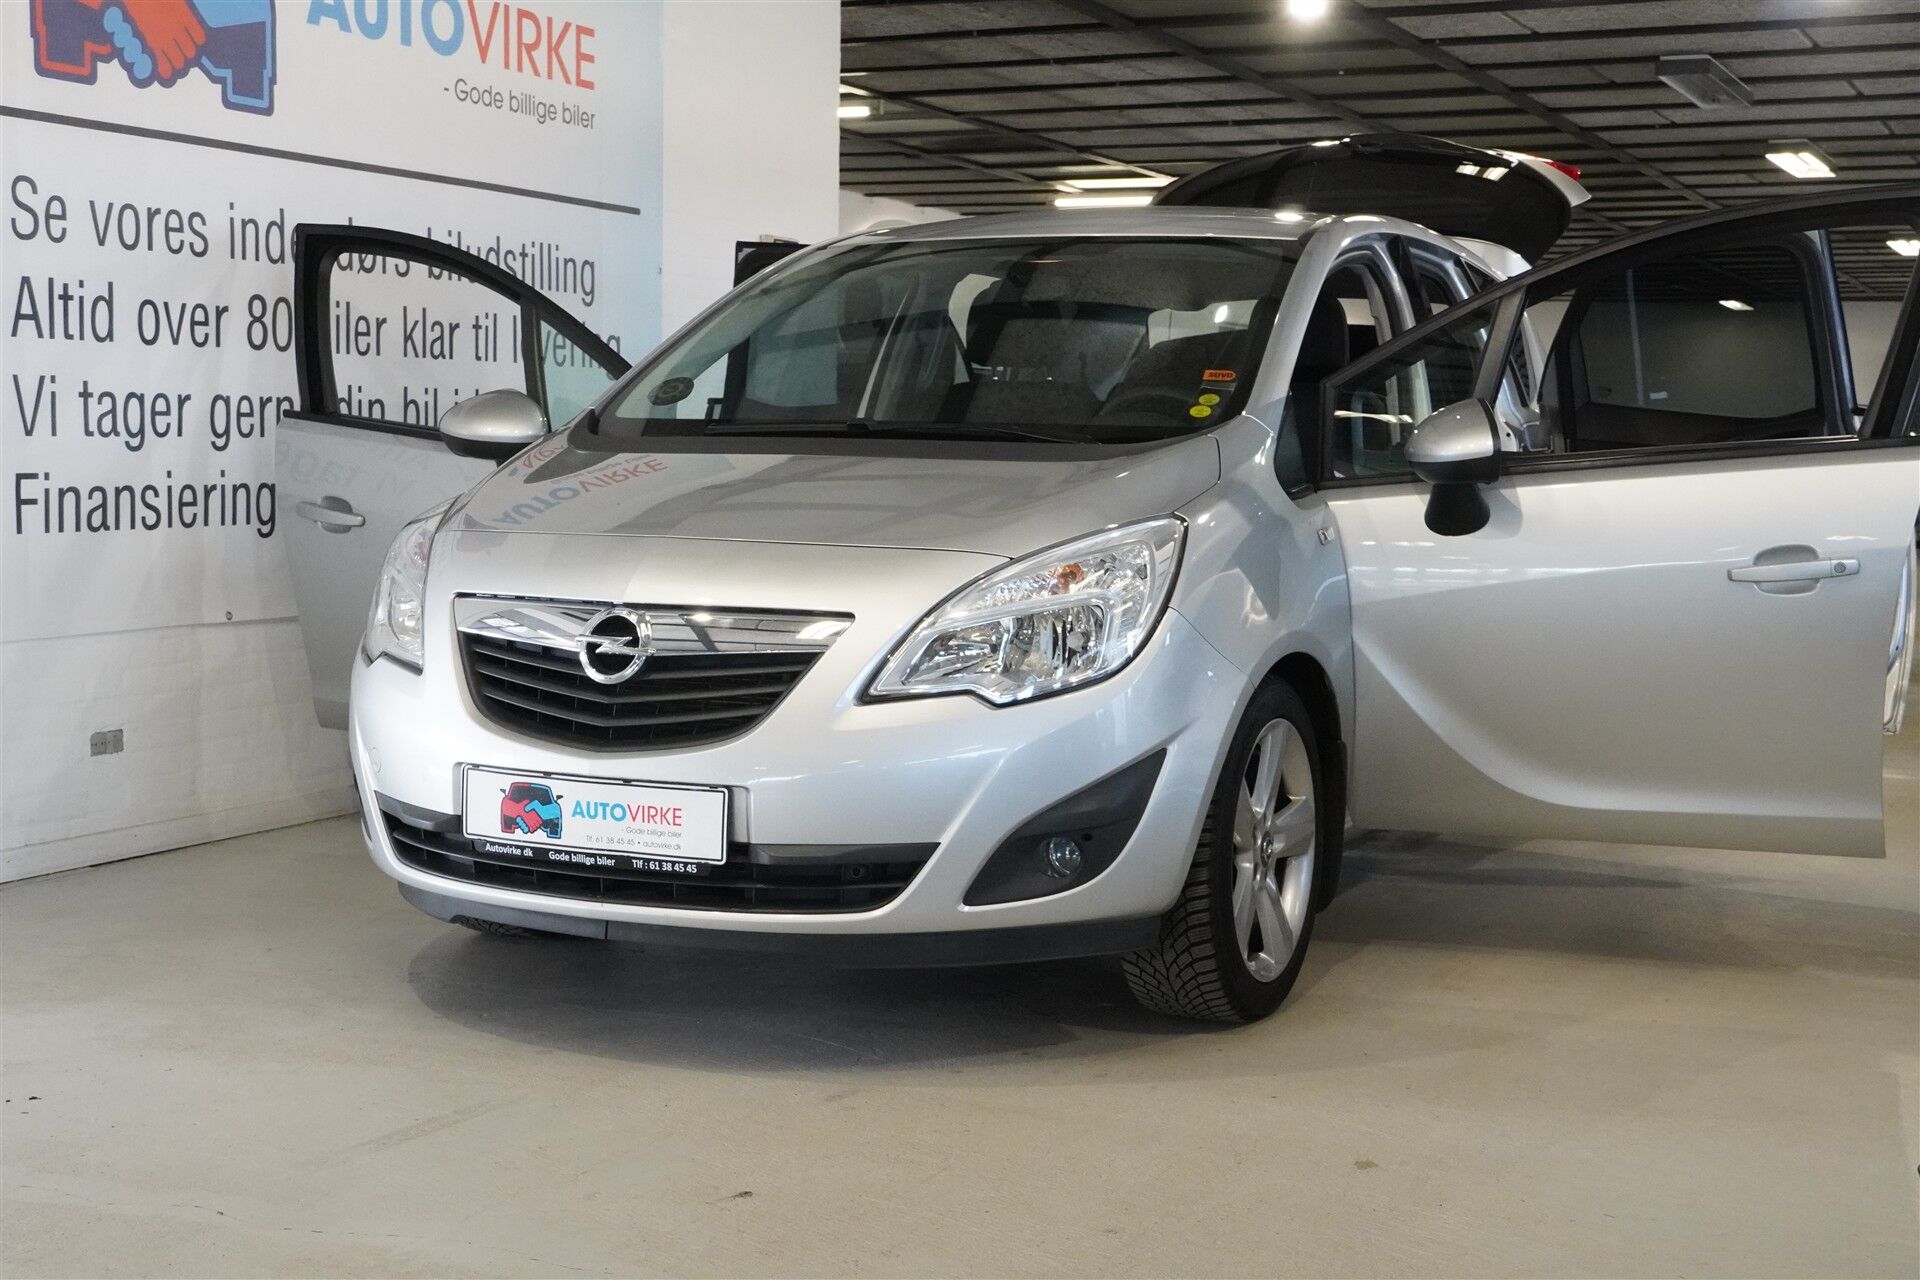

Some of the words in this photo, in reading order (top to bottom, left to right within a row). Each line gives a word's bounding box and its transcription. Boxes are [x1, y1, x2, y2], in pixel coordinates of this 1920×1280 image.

[454, 78, 504, 110] Gode
[509, 90, 557, 125] billige
[562, 102, 596, 130] biler
[10, 174, 68, 244] Se
[89, 199, 209, 258] vores
[10, 275, 115, 343] Altid
[137, 298, 229, 348] over
[246, 293, 293, 352] 80
[335, 300, 388, 357] iler
[403, 305, 461, 360] klar
[472, 312, 498, 362] til
[12, 374, 58, 437] Vi
[77, 380, 192, 452] tager
[14, 469, 277, 539] Finansiering
[571, 799, 682, 827] AUTOVIRKE
[485, 843, 522, 856] Autovirke
[548, 850, 570, 861] Gode
[571, 853, 596, 866] billige
[596, 856, 616, 867] biler
[632, 859, 644, 869] Tlf
[649, 860, 660, 870] 61
[660, 861, 672, 872] 38
[673, 862, 685, 873] 45
[685, 863, 698, 874] 45
